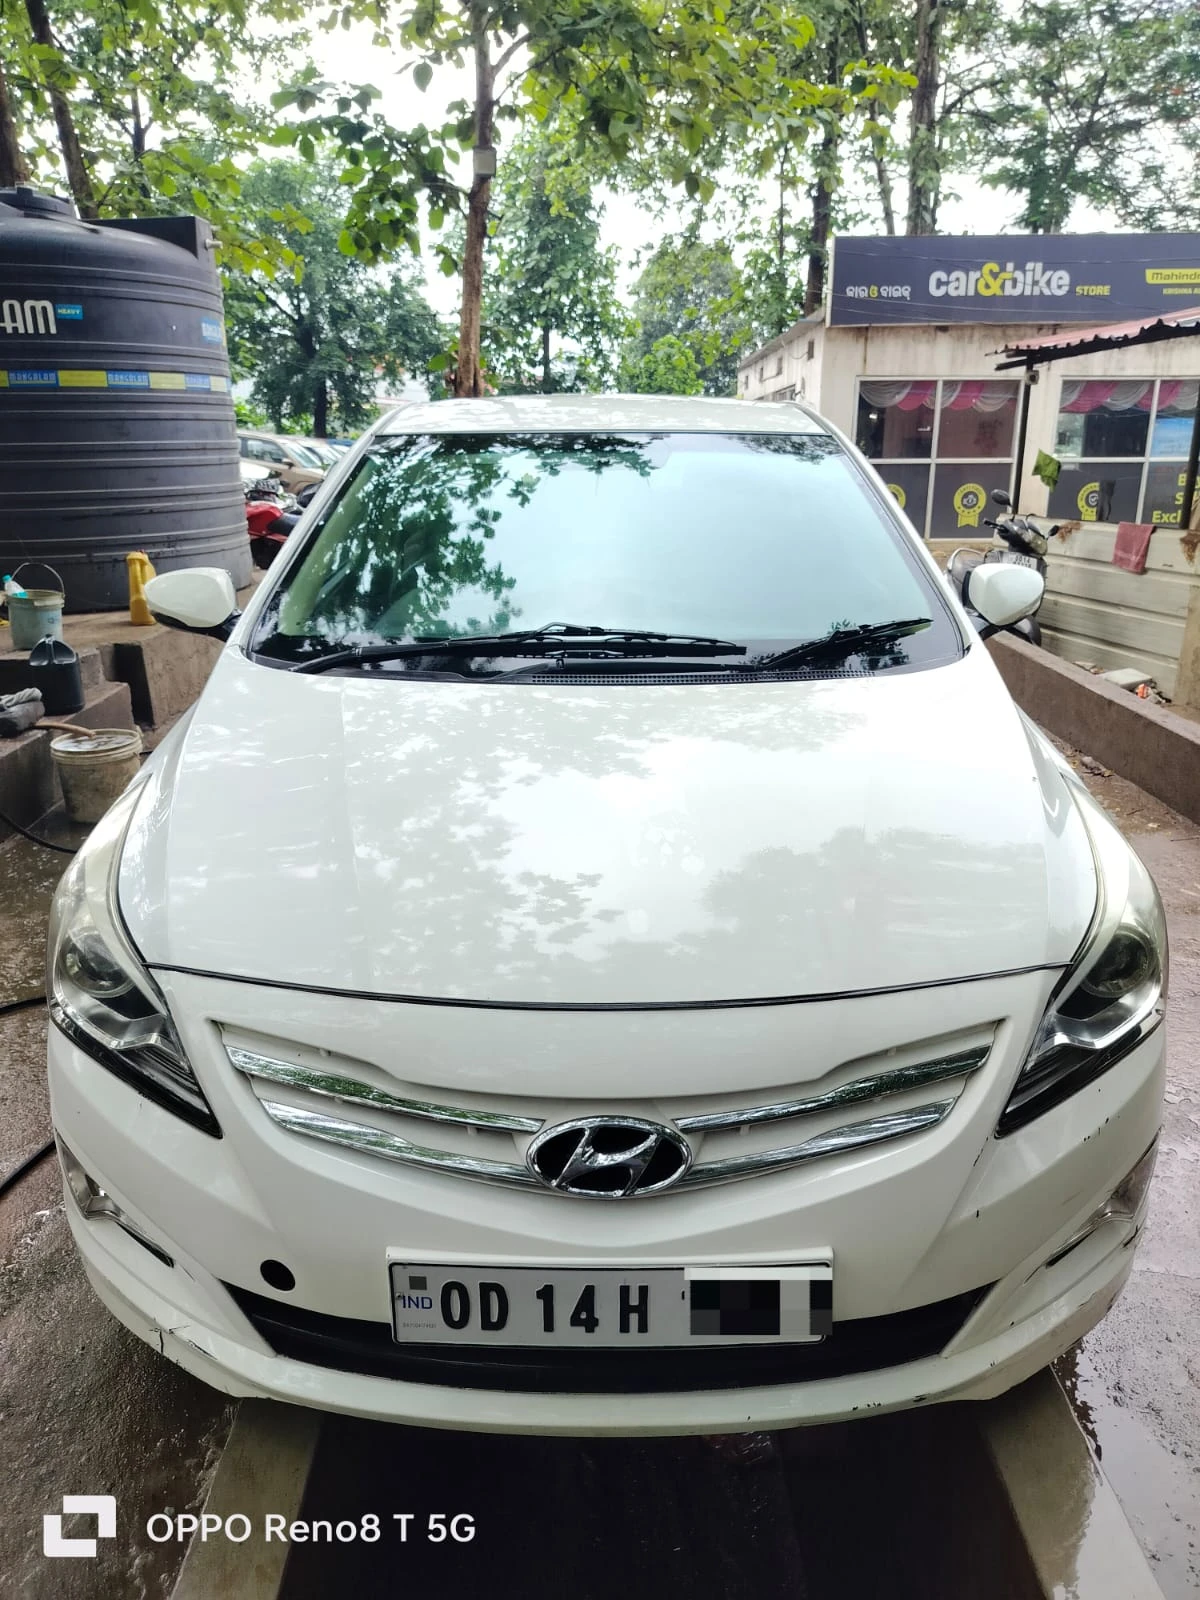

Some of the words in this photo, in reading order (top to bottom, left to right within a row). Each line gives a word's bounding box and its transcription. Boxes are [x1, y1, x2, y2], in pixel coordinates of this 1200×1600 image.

[929, 262, 1070, 297] car&bike
[1075, 285, 1111, 296] STORE
[402, 1295, 433, 1309] IND
[441, 1281, 509, 1331] OD
[536, 1284, 599, 1333] 14
[619, 1285, 649, 1333] H
